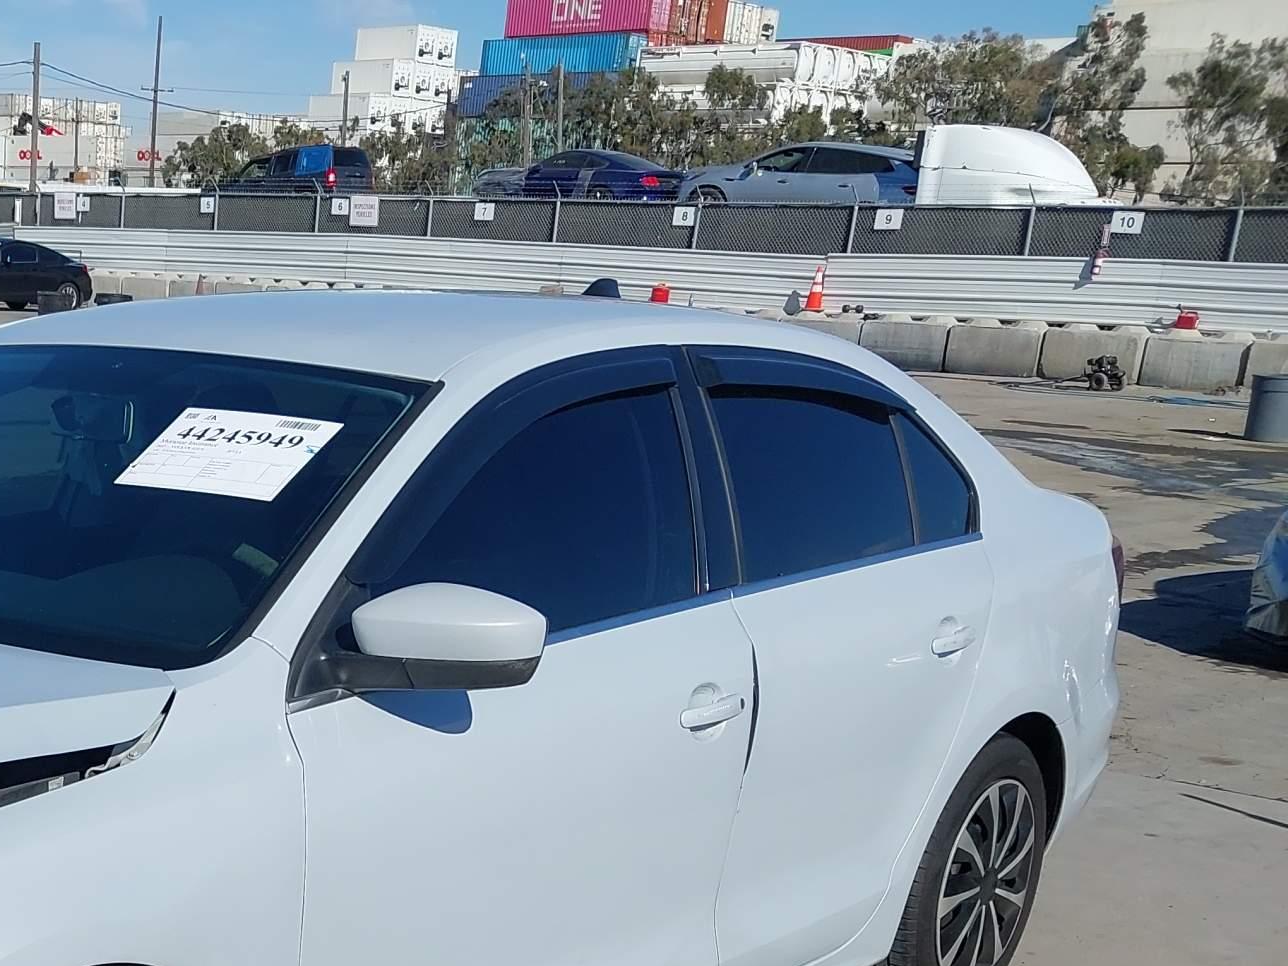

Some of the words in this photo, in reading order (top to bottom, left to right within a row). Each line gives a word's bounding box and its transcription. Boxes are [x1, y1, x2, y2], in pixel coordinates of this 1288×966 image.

[551, 0, 602, 22] ONE
[18, 150, 42, 160] OOL
[482, 207, 487, 216] 7
[682, 211, 688, 221] 8
[885, 214, 892, 225] 9
[1119, 216, 1136, 229] 10
[177, 425, 305, 449] 44245949
